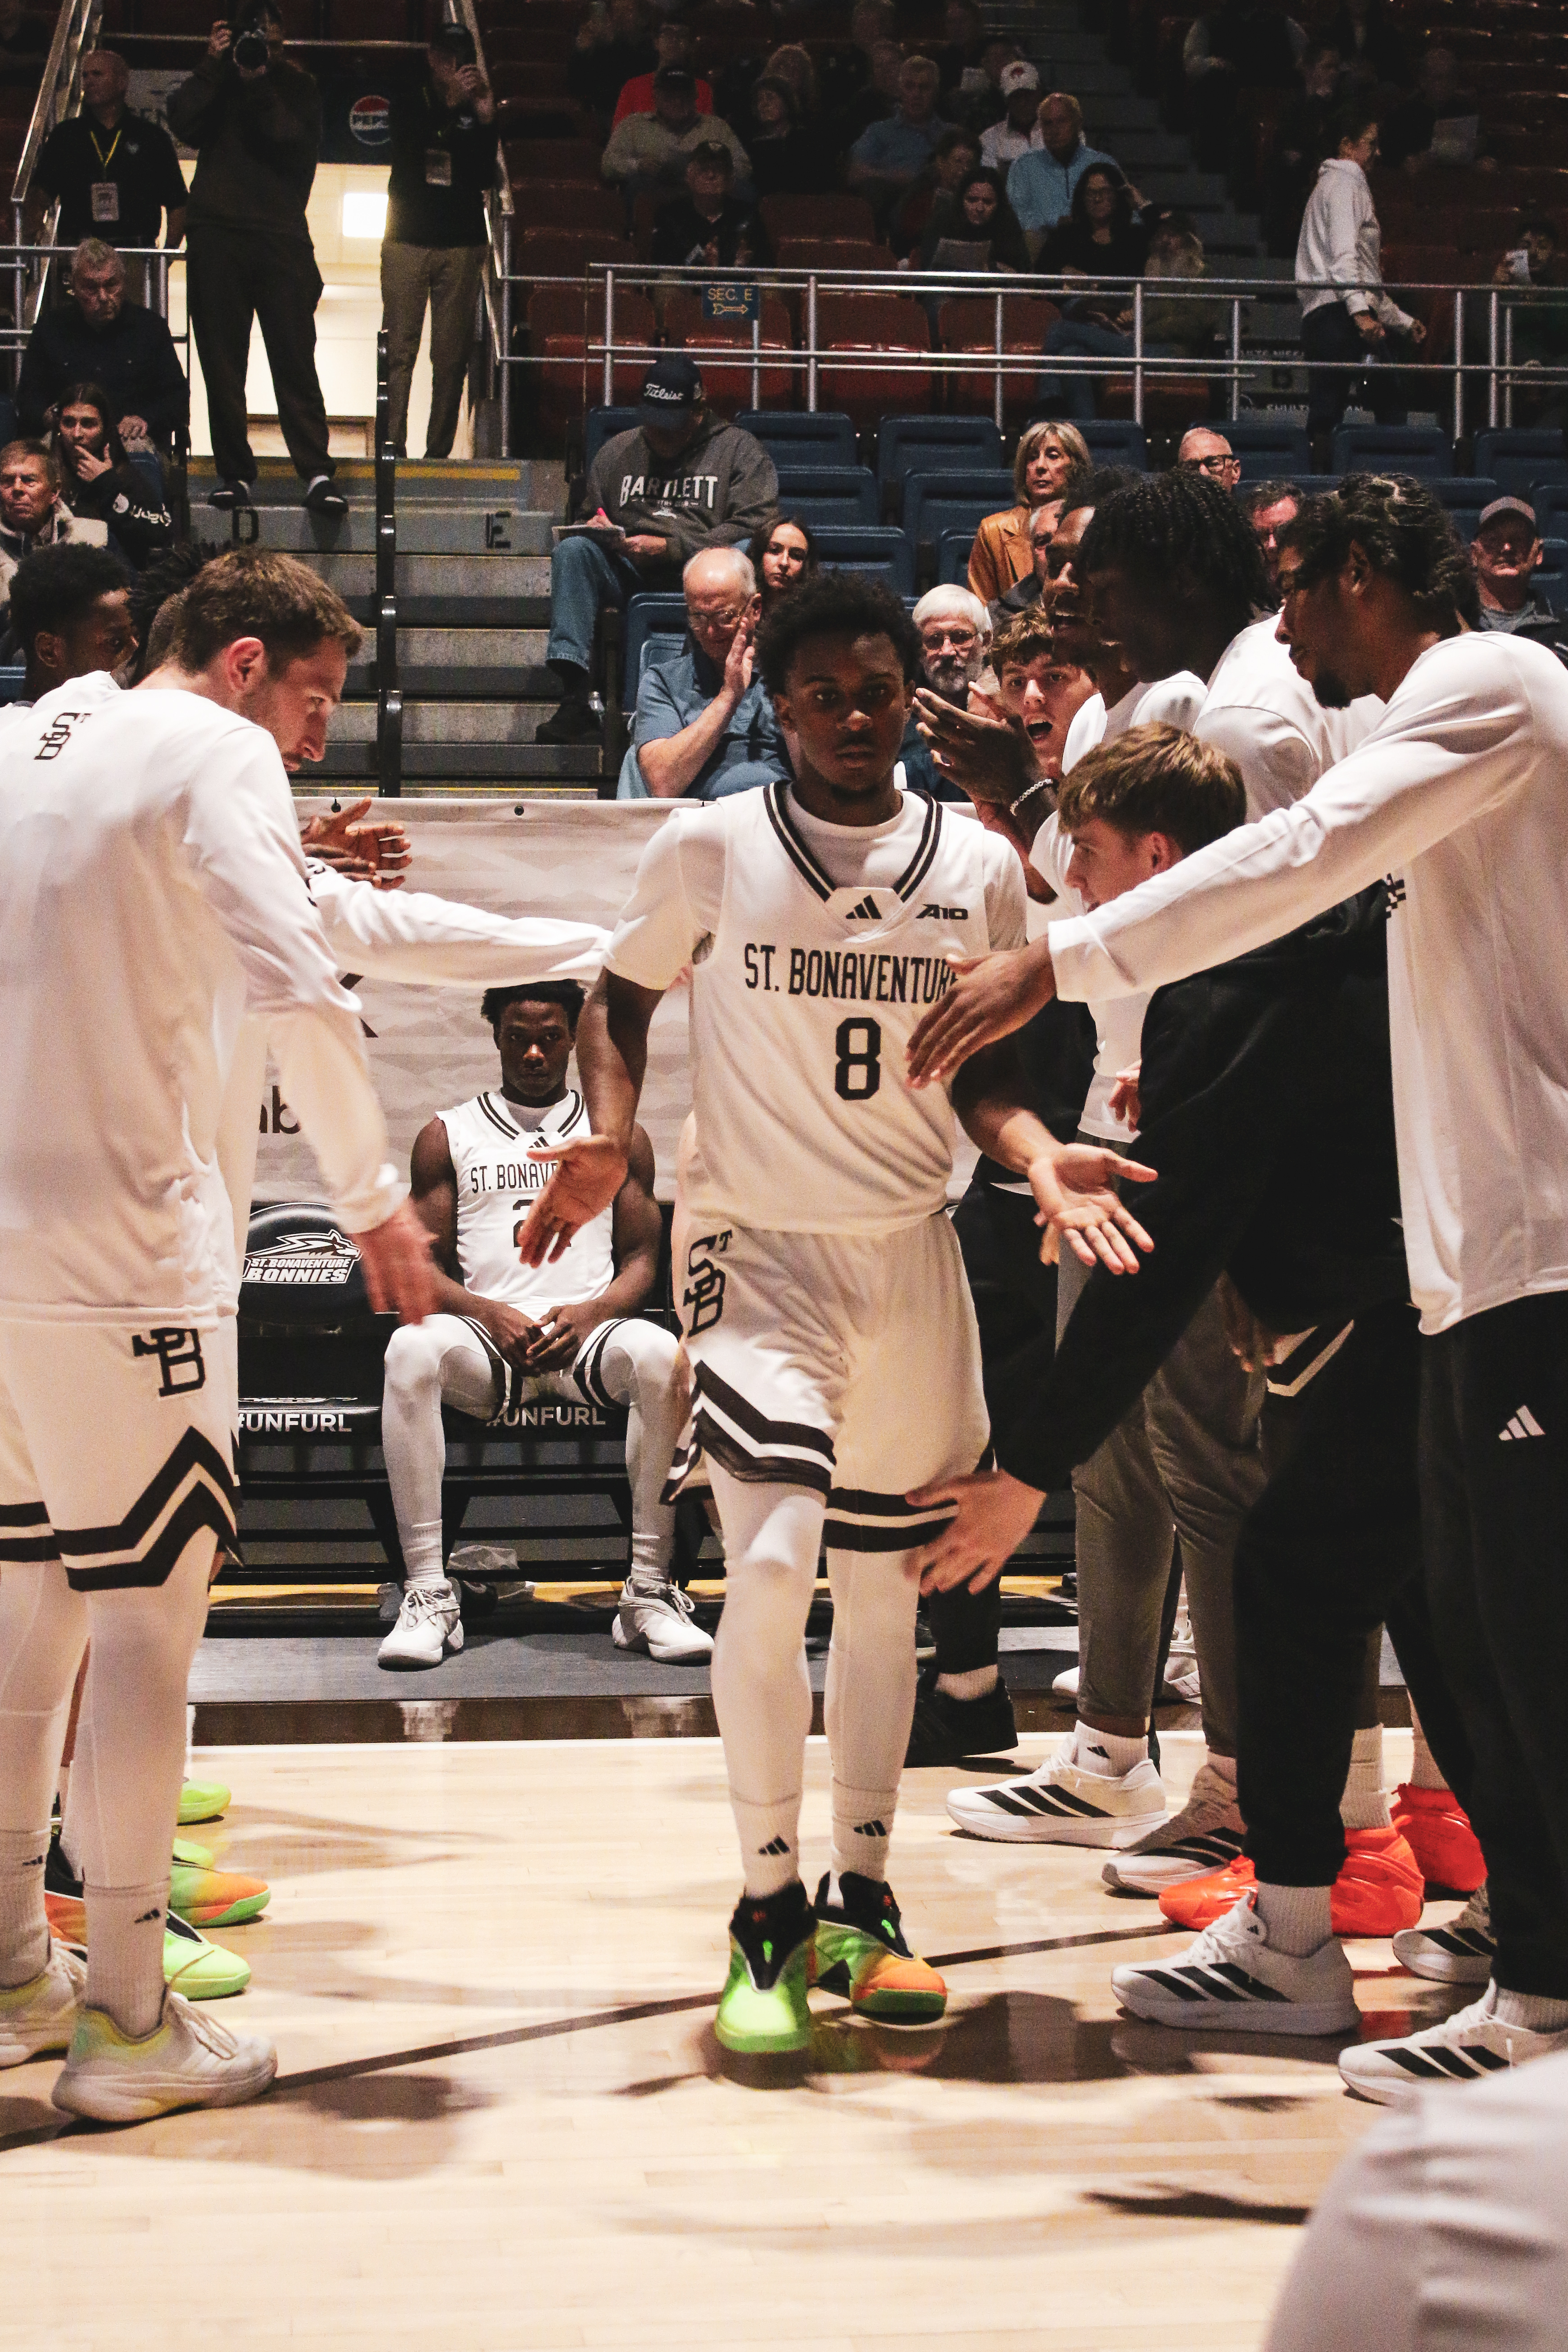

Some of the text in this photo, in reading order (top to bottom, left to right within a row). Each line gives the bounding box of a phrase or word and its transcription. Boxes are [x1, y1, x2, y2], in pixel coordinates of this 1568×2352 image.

[353, 114, 389, 125] PEPS
[707, 288, 753, 301] SEC. E
[644, 383, 684, 400] Titleist
[619, 475, 718, 509] BARTLETT
[232, 507, 259, 545] D
[486, 511, 511, 548] E
[916, 904, 969, 920] A10
[744, 943, 958, 1004] ST. BONAVENTUR
[835, 1017, 881, 1101] 8
[471, 1163, 558, 1193] ST. BONAV
[248, 1267, 348, 1282] BONNIES
